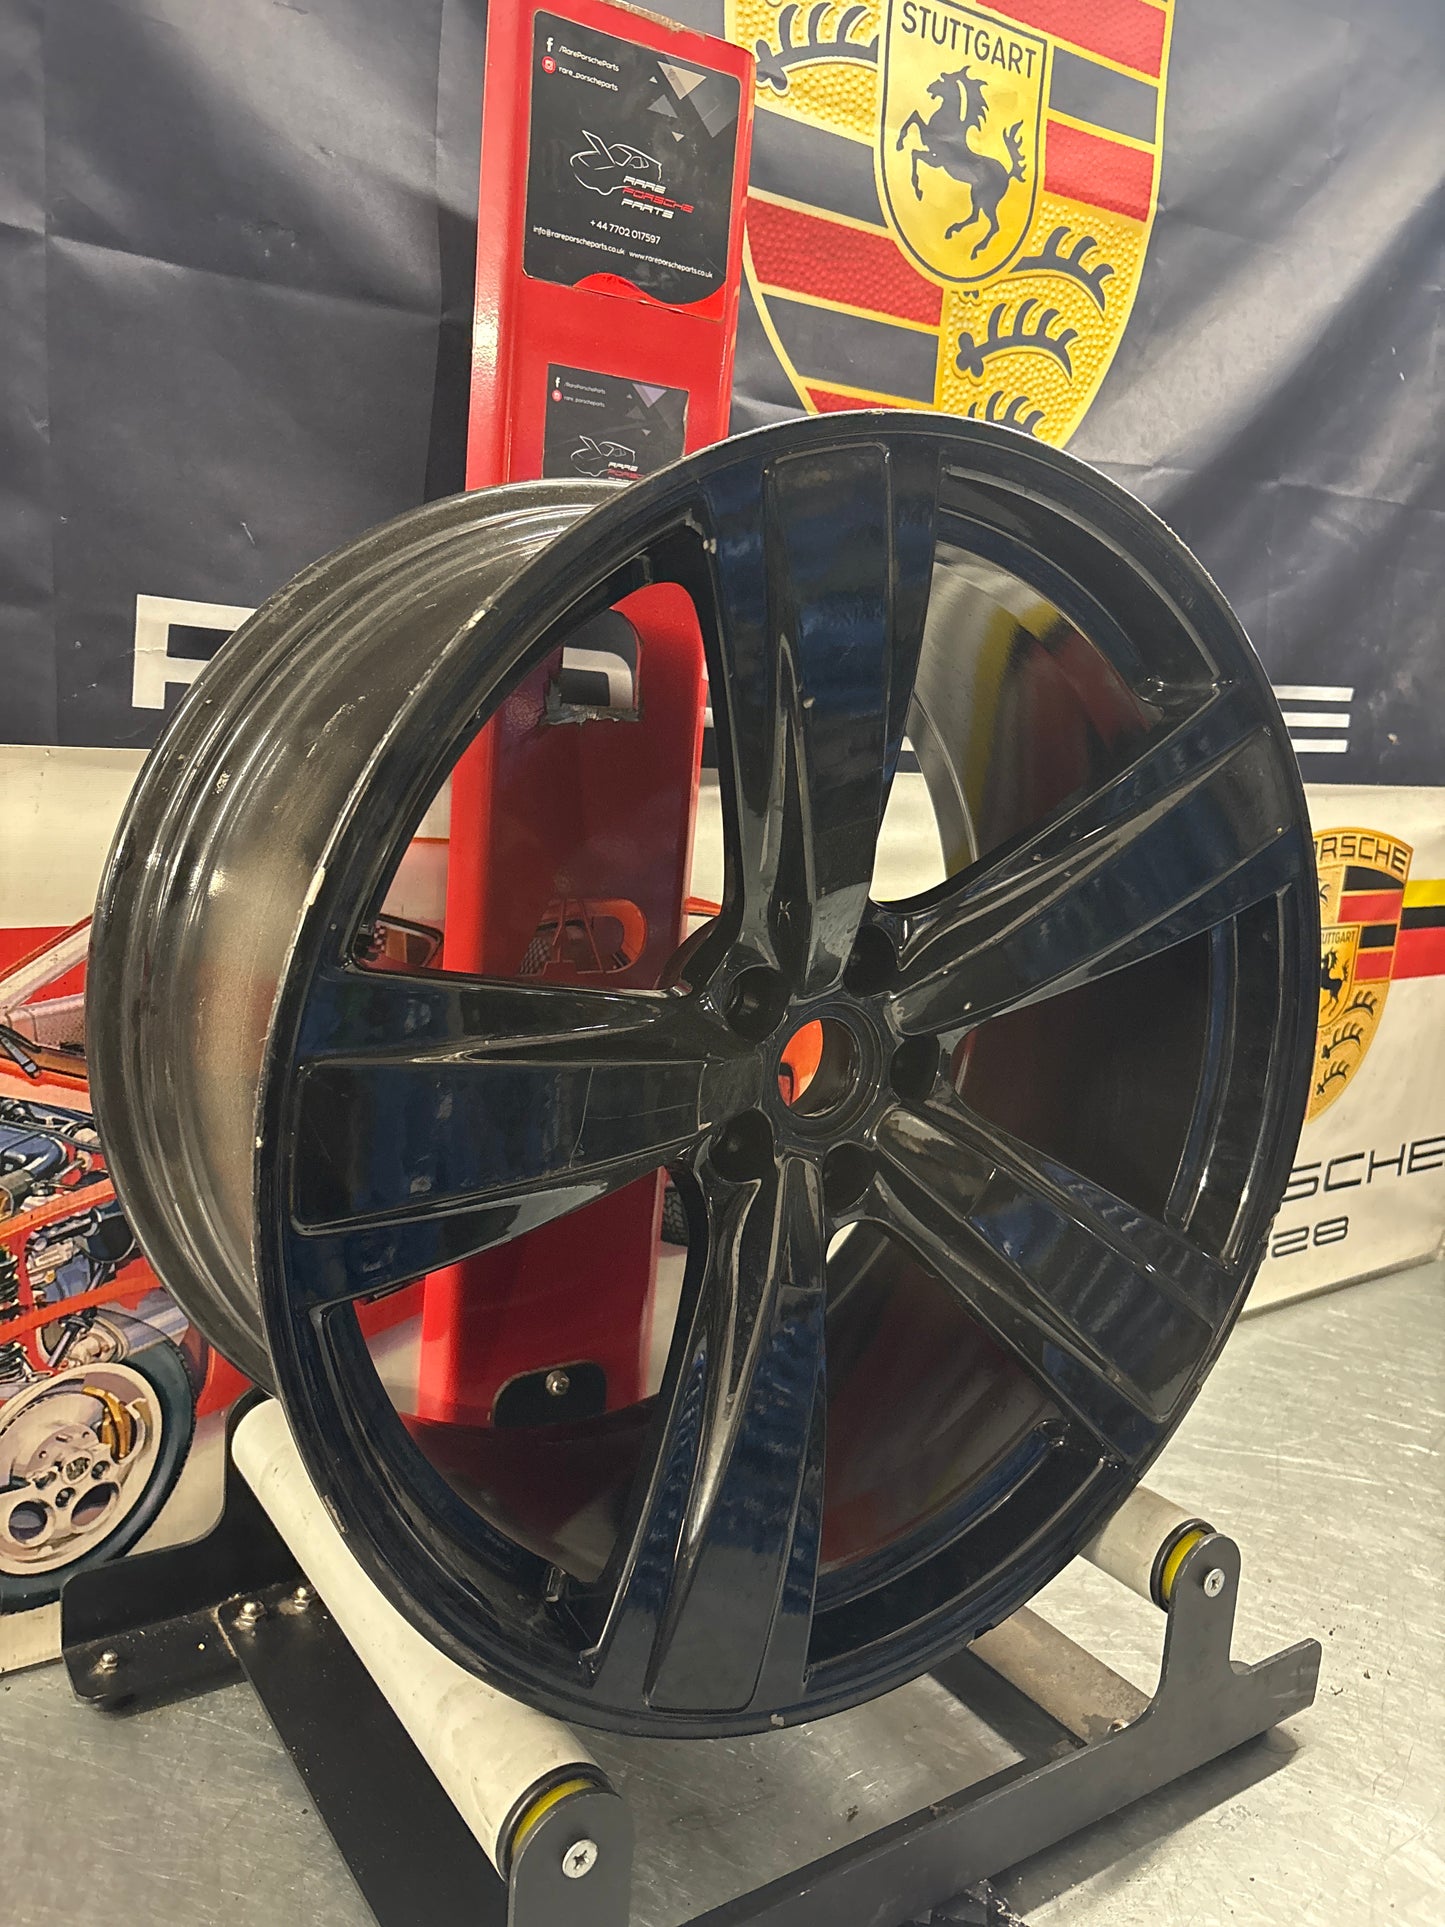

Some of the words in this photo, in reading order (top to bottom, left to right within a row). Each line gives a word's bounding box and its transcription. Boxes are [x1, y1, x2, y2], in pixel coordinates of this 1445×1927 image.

[901, 1, 1037, 79] STUTTGART
[623, 175, 667, 194] RARE
[621, 198, 675, 220] PARTS
[622, 187, 695, 214] PORSCHE
[609, 223, 631, 237] 7702
[631, 229, 661, 245] 017597
[629, 250, 713, 279] www.rareporscheparts.co.uk
[1314, 836, 1408, 875] RSCHE
[1321, 930, 1356, 945] UTTGART
[1282, 1136, 1445, 1202] SCHE
[1271, 1216, 1349, 1258] 28
